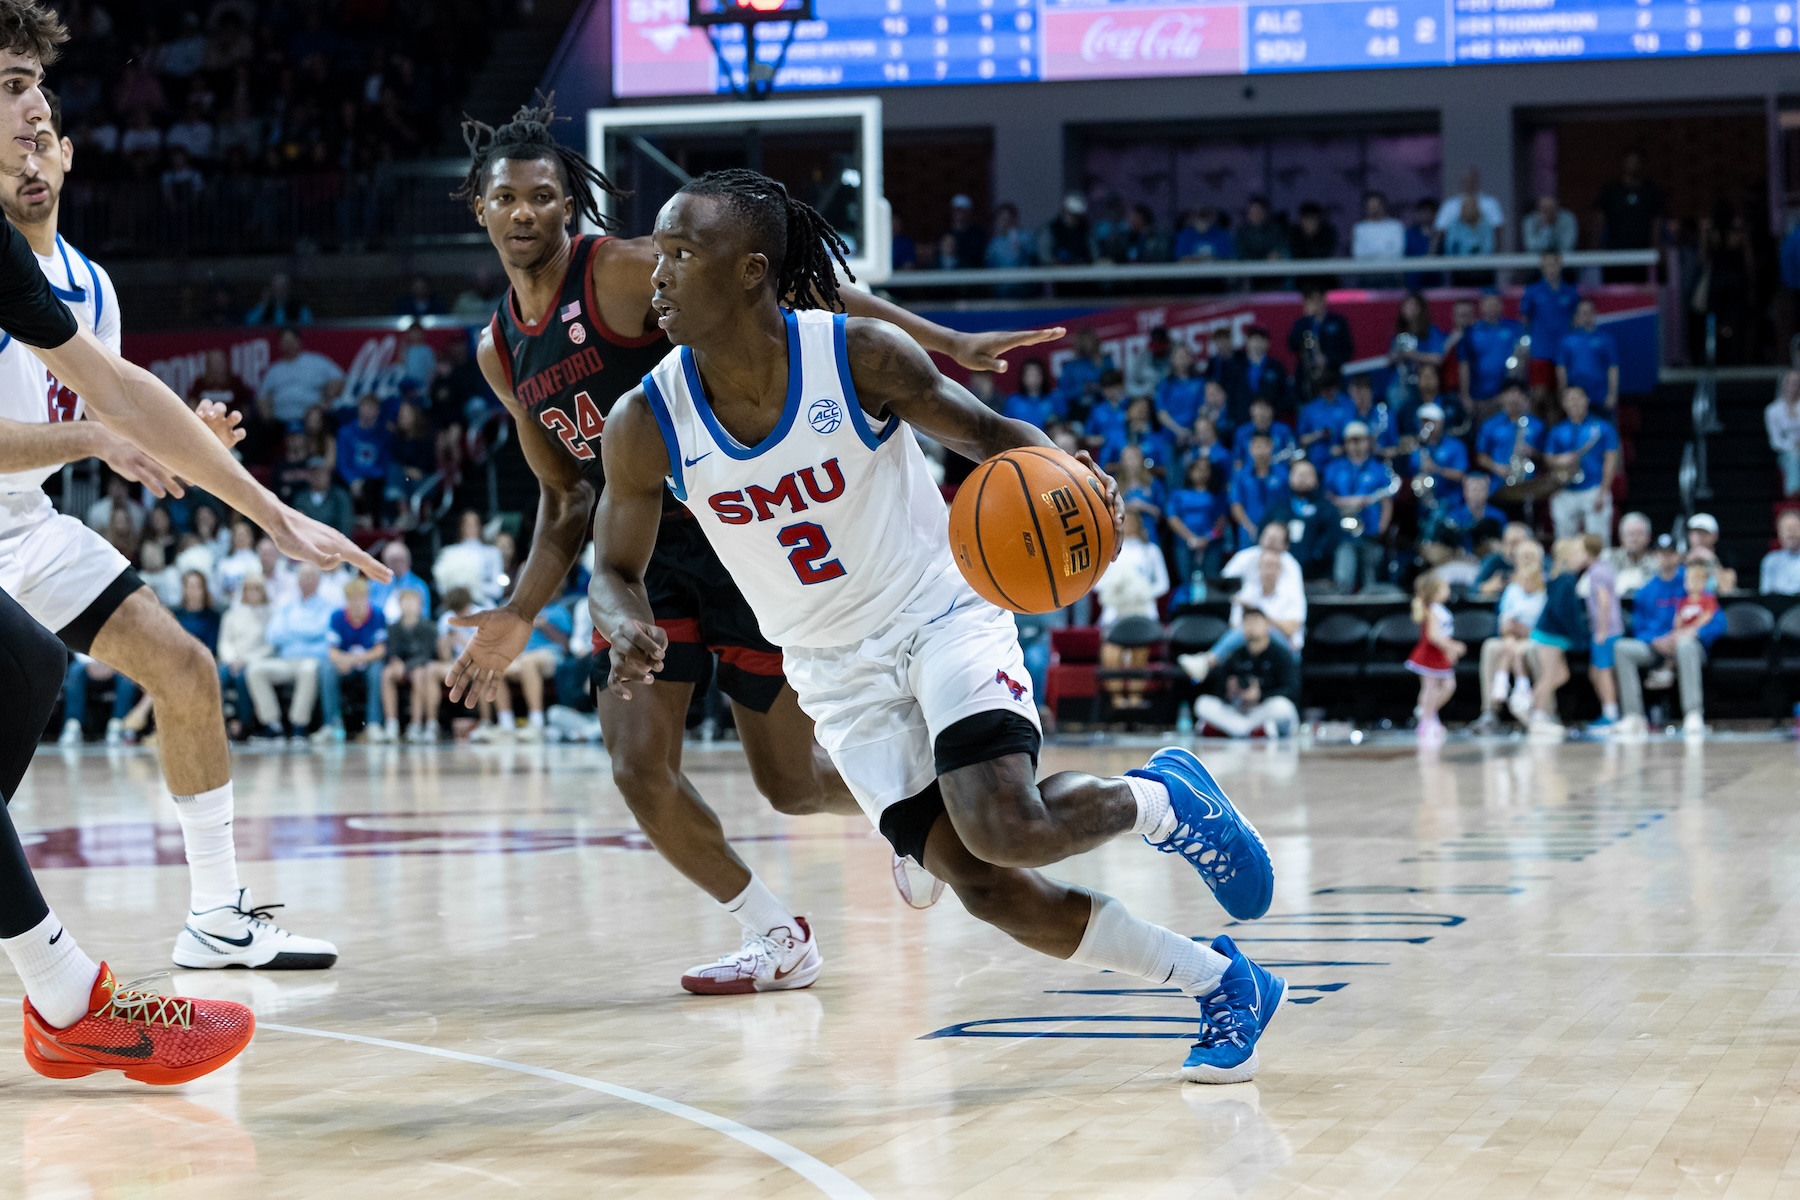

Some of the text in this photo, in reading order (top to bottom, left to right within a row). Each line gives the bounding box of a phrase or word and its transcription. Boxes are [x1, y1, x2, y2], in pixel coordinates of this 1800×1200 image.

[1255, 9, 1303, 34] ALC
[516, 346, 605, 409] STANFORD
[540, 391, 607, 460] 24
[813, 406, 840, 422] ACC
[708, 457, 846, 525] SMU
[776, 521, 848, 585] 2
[1048, 484, 1092, 576] ELITE
